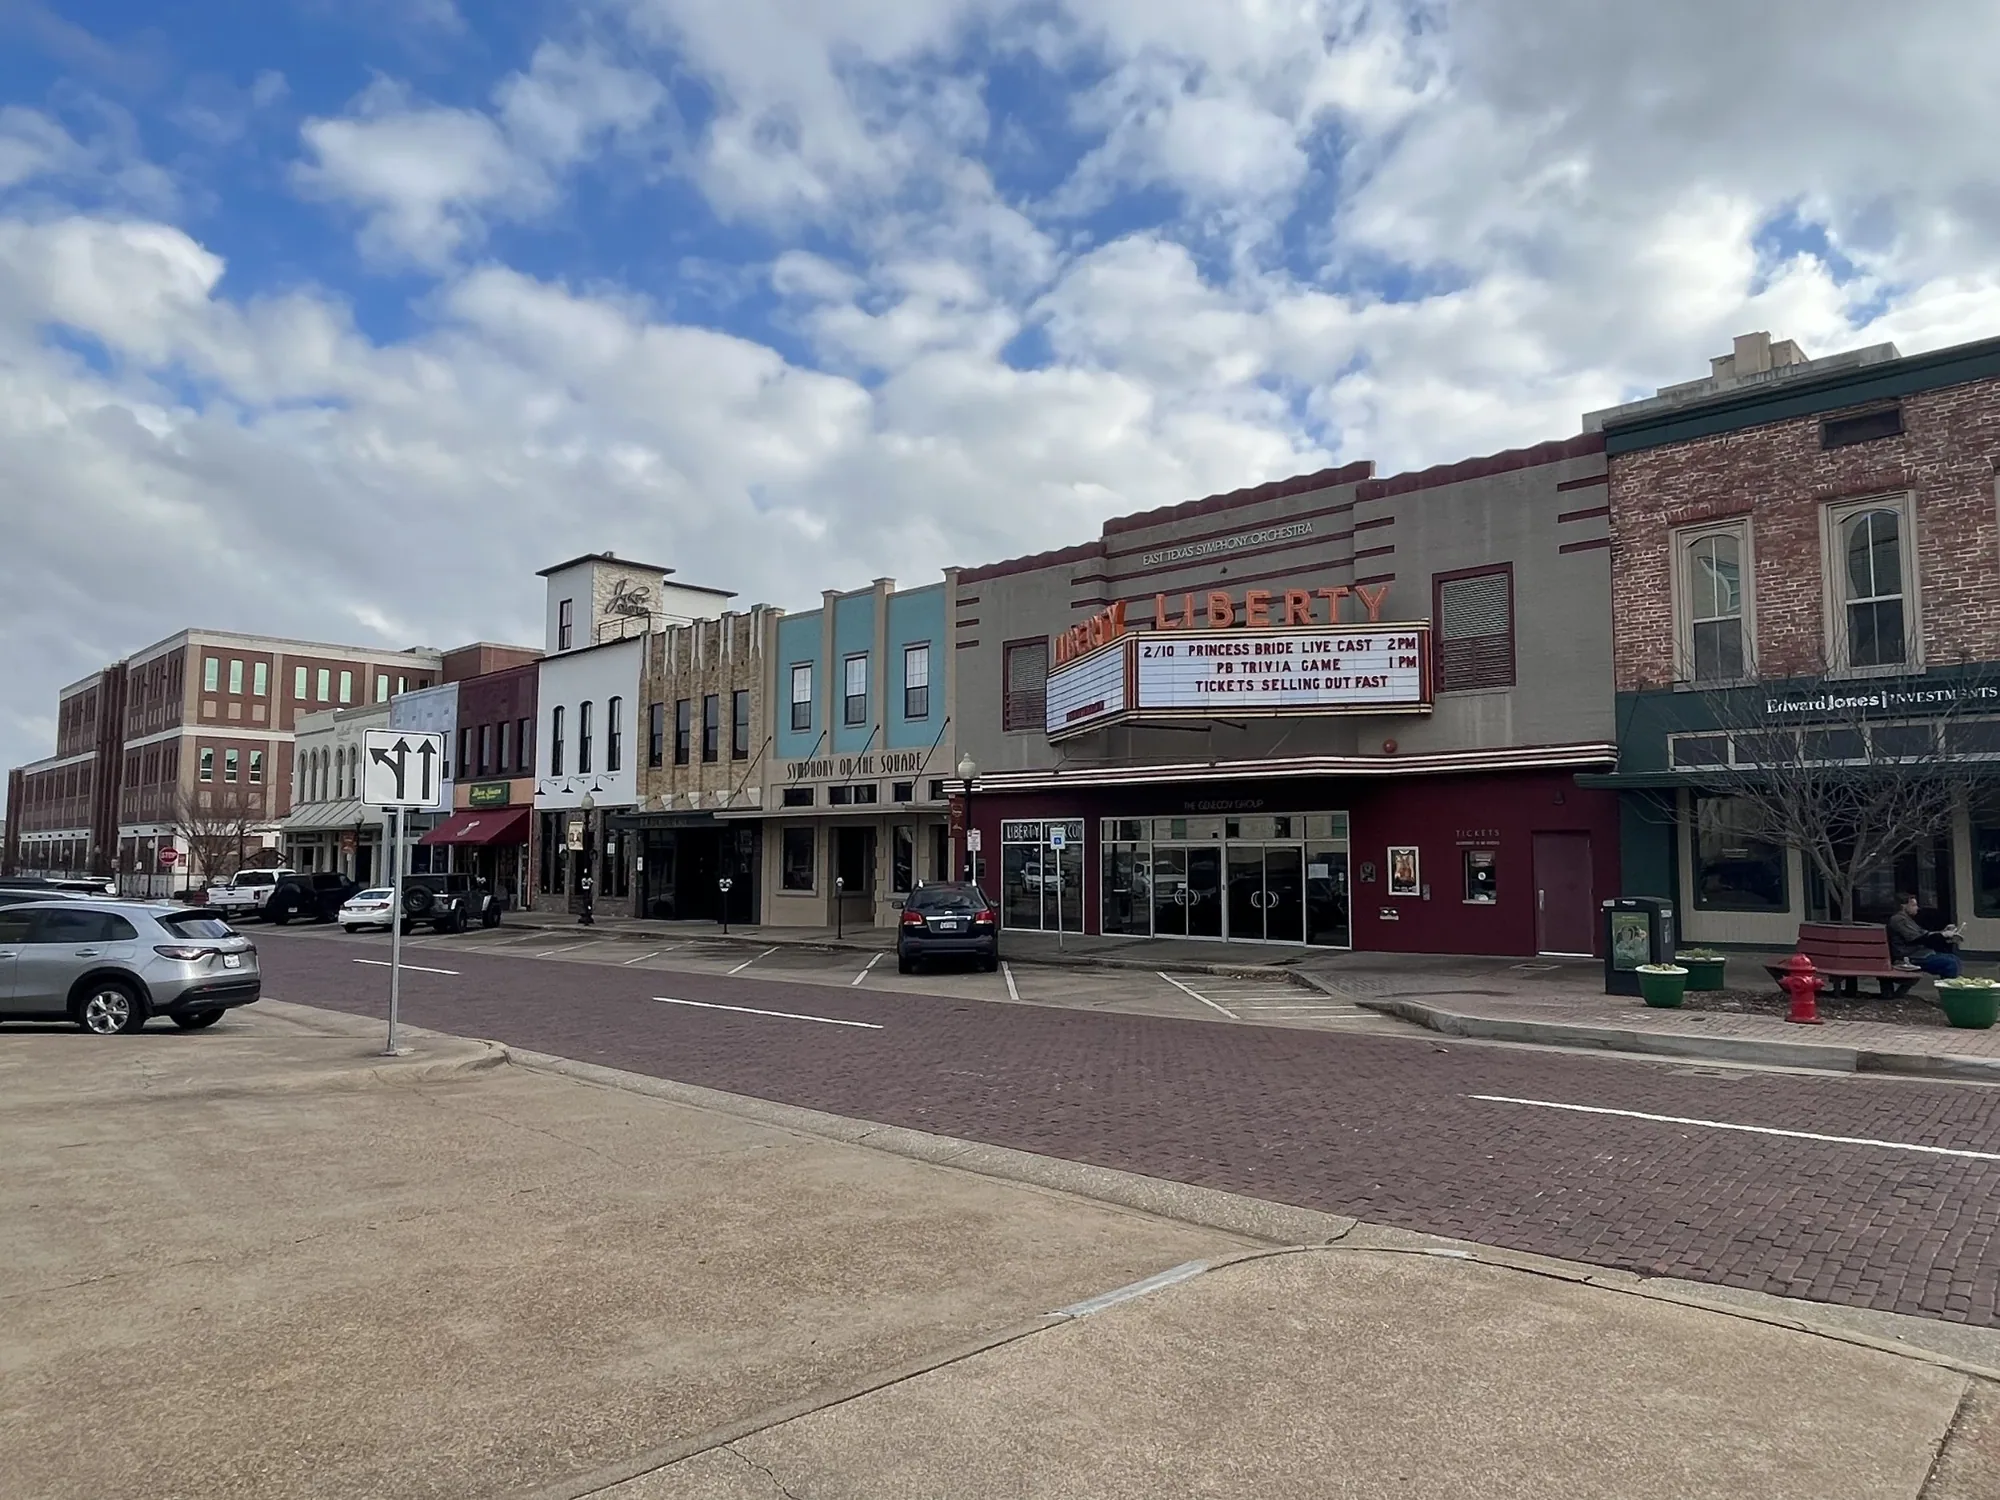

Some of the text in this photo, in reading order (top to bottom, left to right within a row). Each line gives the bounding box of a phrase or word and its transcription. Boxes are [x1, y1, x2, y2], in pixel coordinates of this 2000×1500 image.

[1143, 522, 1313, 565] EAST TEXAS SYMPHONY ORCHESTRA
[1154, 585, 1389, 631] LIBERTY
[1054, 599, 1127, 666] LIBERTY
[1143, 645, 1174, 658] 2/10
[1188, 643, 1250, 657] PRINCESS
[1254, 642, 1294, 655] BRIDE
[1302, 640, 1331, 654] LIVE
[1337, 638, 1372, 652] CAST
[1216, 662, 1233, 674] PB
[1241, 660, 1292, 673] TRIVIA
[1301, 658, 1341, 672] GAME
[1195, 675, 1388, 693] TICKETS SELLING OUT FAST
[858, 756, 874, 774] THE
[881, 752, 922, 774] SQUARE
[1006, 824, 1040, 839] LIBERTY
[1455, 829, 1500, 837] TICKETS
